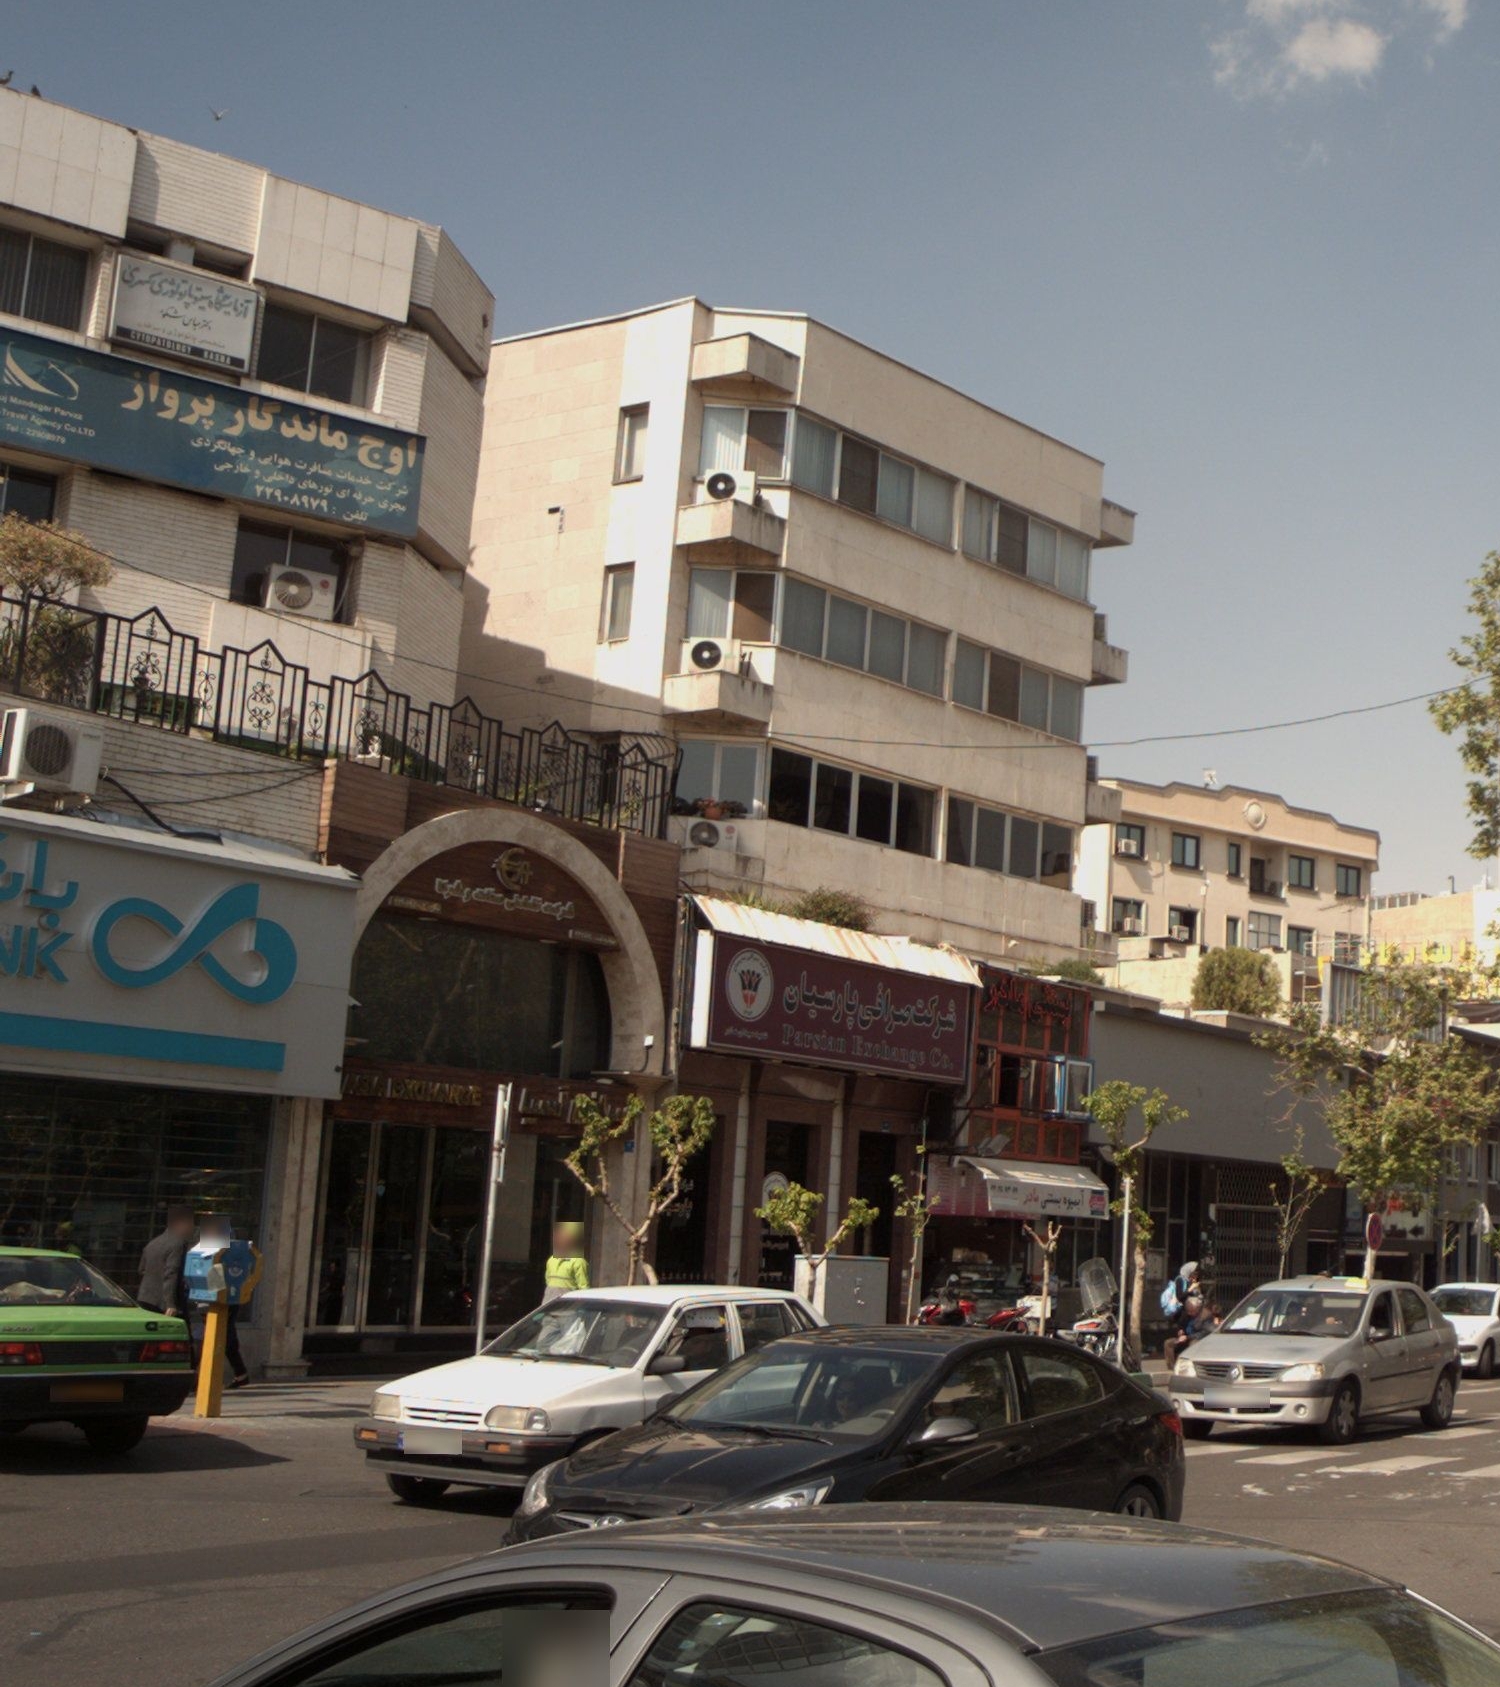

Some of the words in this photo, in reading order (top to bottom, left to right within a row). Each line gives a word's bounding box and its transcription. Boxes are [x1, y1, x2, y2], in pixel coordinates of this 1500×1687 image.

[121, 371, 215, 430] پرواز
[30, 414, 64, 431] Agency
[54, 406, 83, 421] Parvaz
[222, 396, 348, 450] ماندگار
[190, 436, 245, 456] جهانگردی
[257, 453, 292, 469] هوایی
[358, 435, 417, 476] اوج
[213, 461, 251, 474] خارجی
[262, 471, 295, 485] داخلی
[335, 471, 372, 486] خدمات
[375, 479, 409, 497] شرکت
[377, 499, 407, 513] مجری
[342, 510, 369, 523] تلفن
[0, 924, 75, 983] NK
[782, 970, 859, 1029] پارسیان
[858, 982, 911, 1034] صرافی
[911, 995, 957, 1040] شرکت
[781, 1023, 846, 1053] Parsian
[852, 1034, 926, 1068] Exchange
[929, 1047, 954, 1070] Co.
[1040, 1193, 1062, 1210] بستنی
